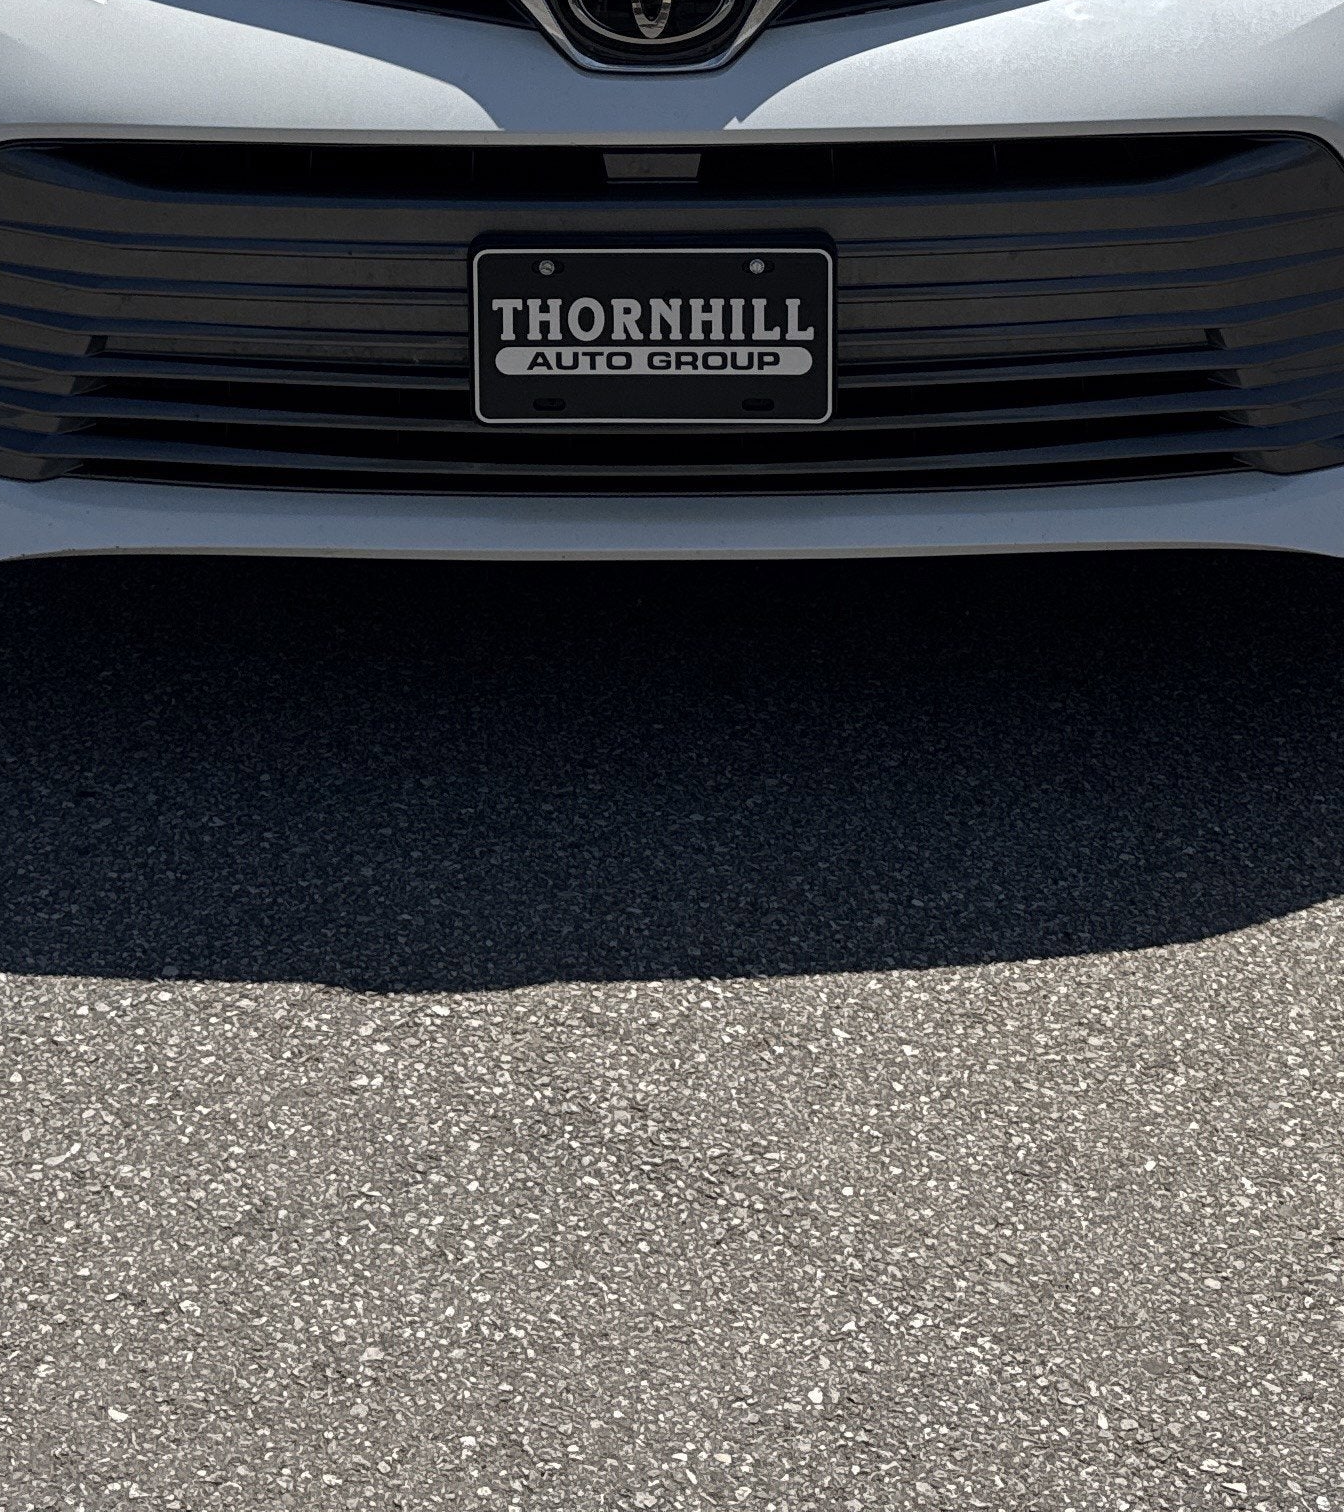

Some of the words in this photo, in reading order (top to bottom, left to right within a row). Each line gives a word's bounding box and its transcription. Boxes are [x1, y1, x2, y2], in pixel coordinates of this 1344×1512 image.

[492, 297, 815, 341] THORNHILL
[526, 351, 633, 371] AUTO
[646, 351, 781, 371] GROUP
